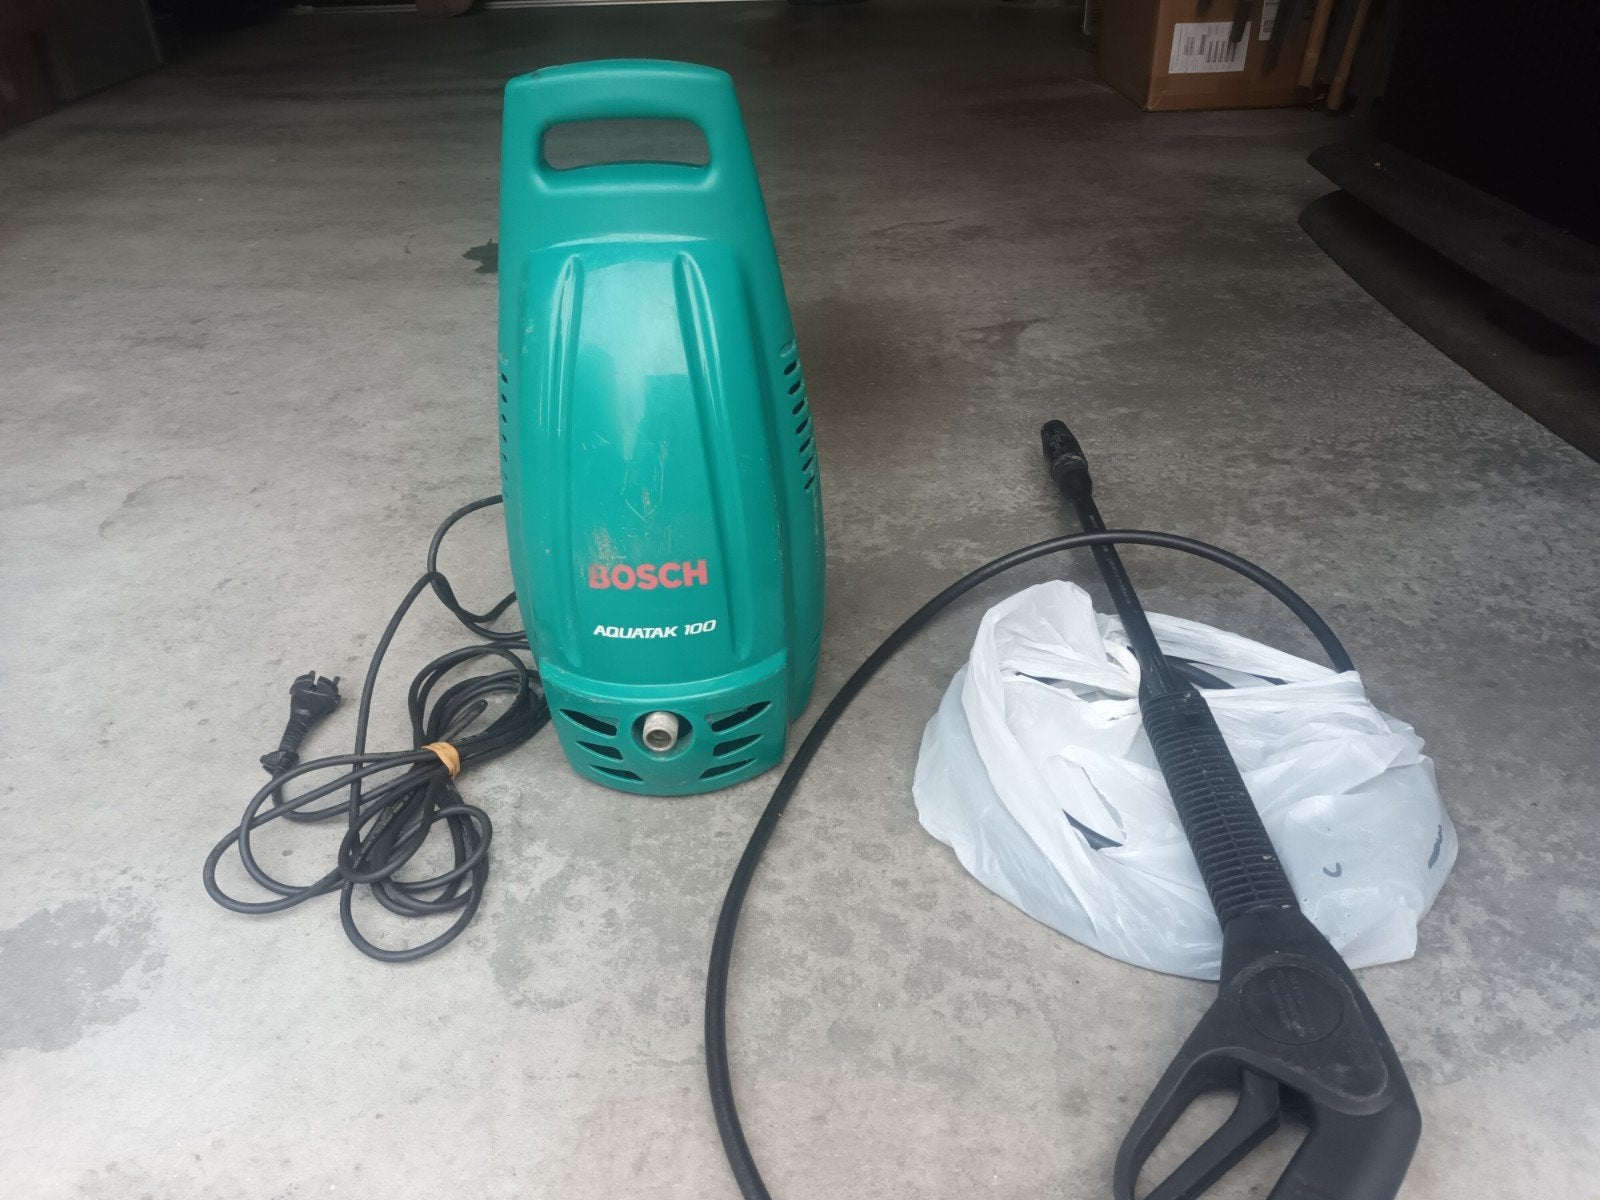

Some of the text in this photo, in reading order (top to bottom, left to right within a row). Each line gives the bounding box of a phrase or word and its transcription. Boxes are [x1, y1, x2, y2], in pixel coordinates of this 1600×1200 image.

[588, 559, 708, 590] BOSCH
[593, 619, 717, 639] AQUATAK 100
